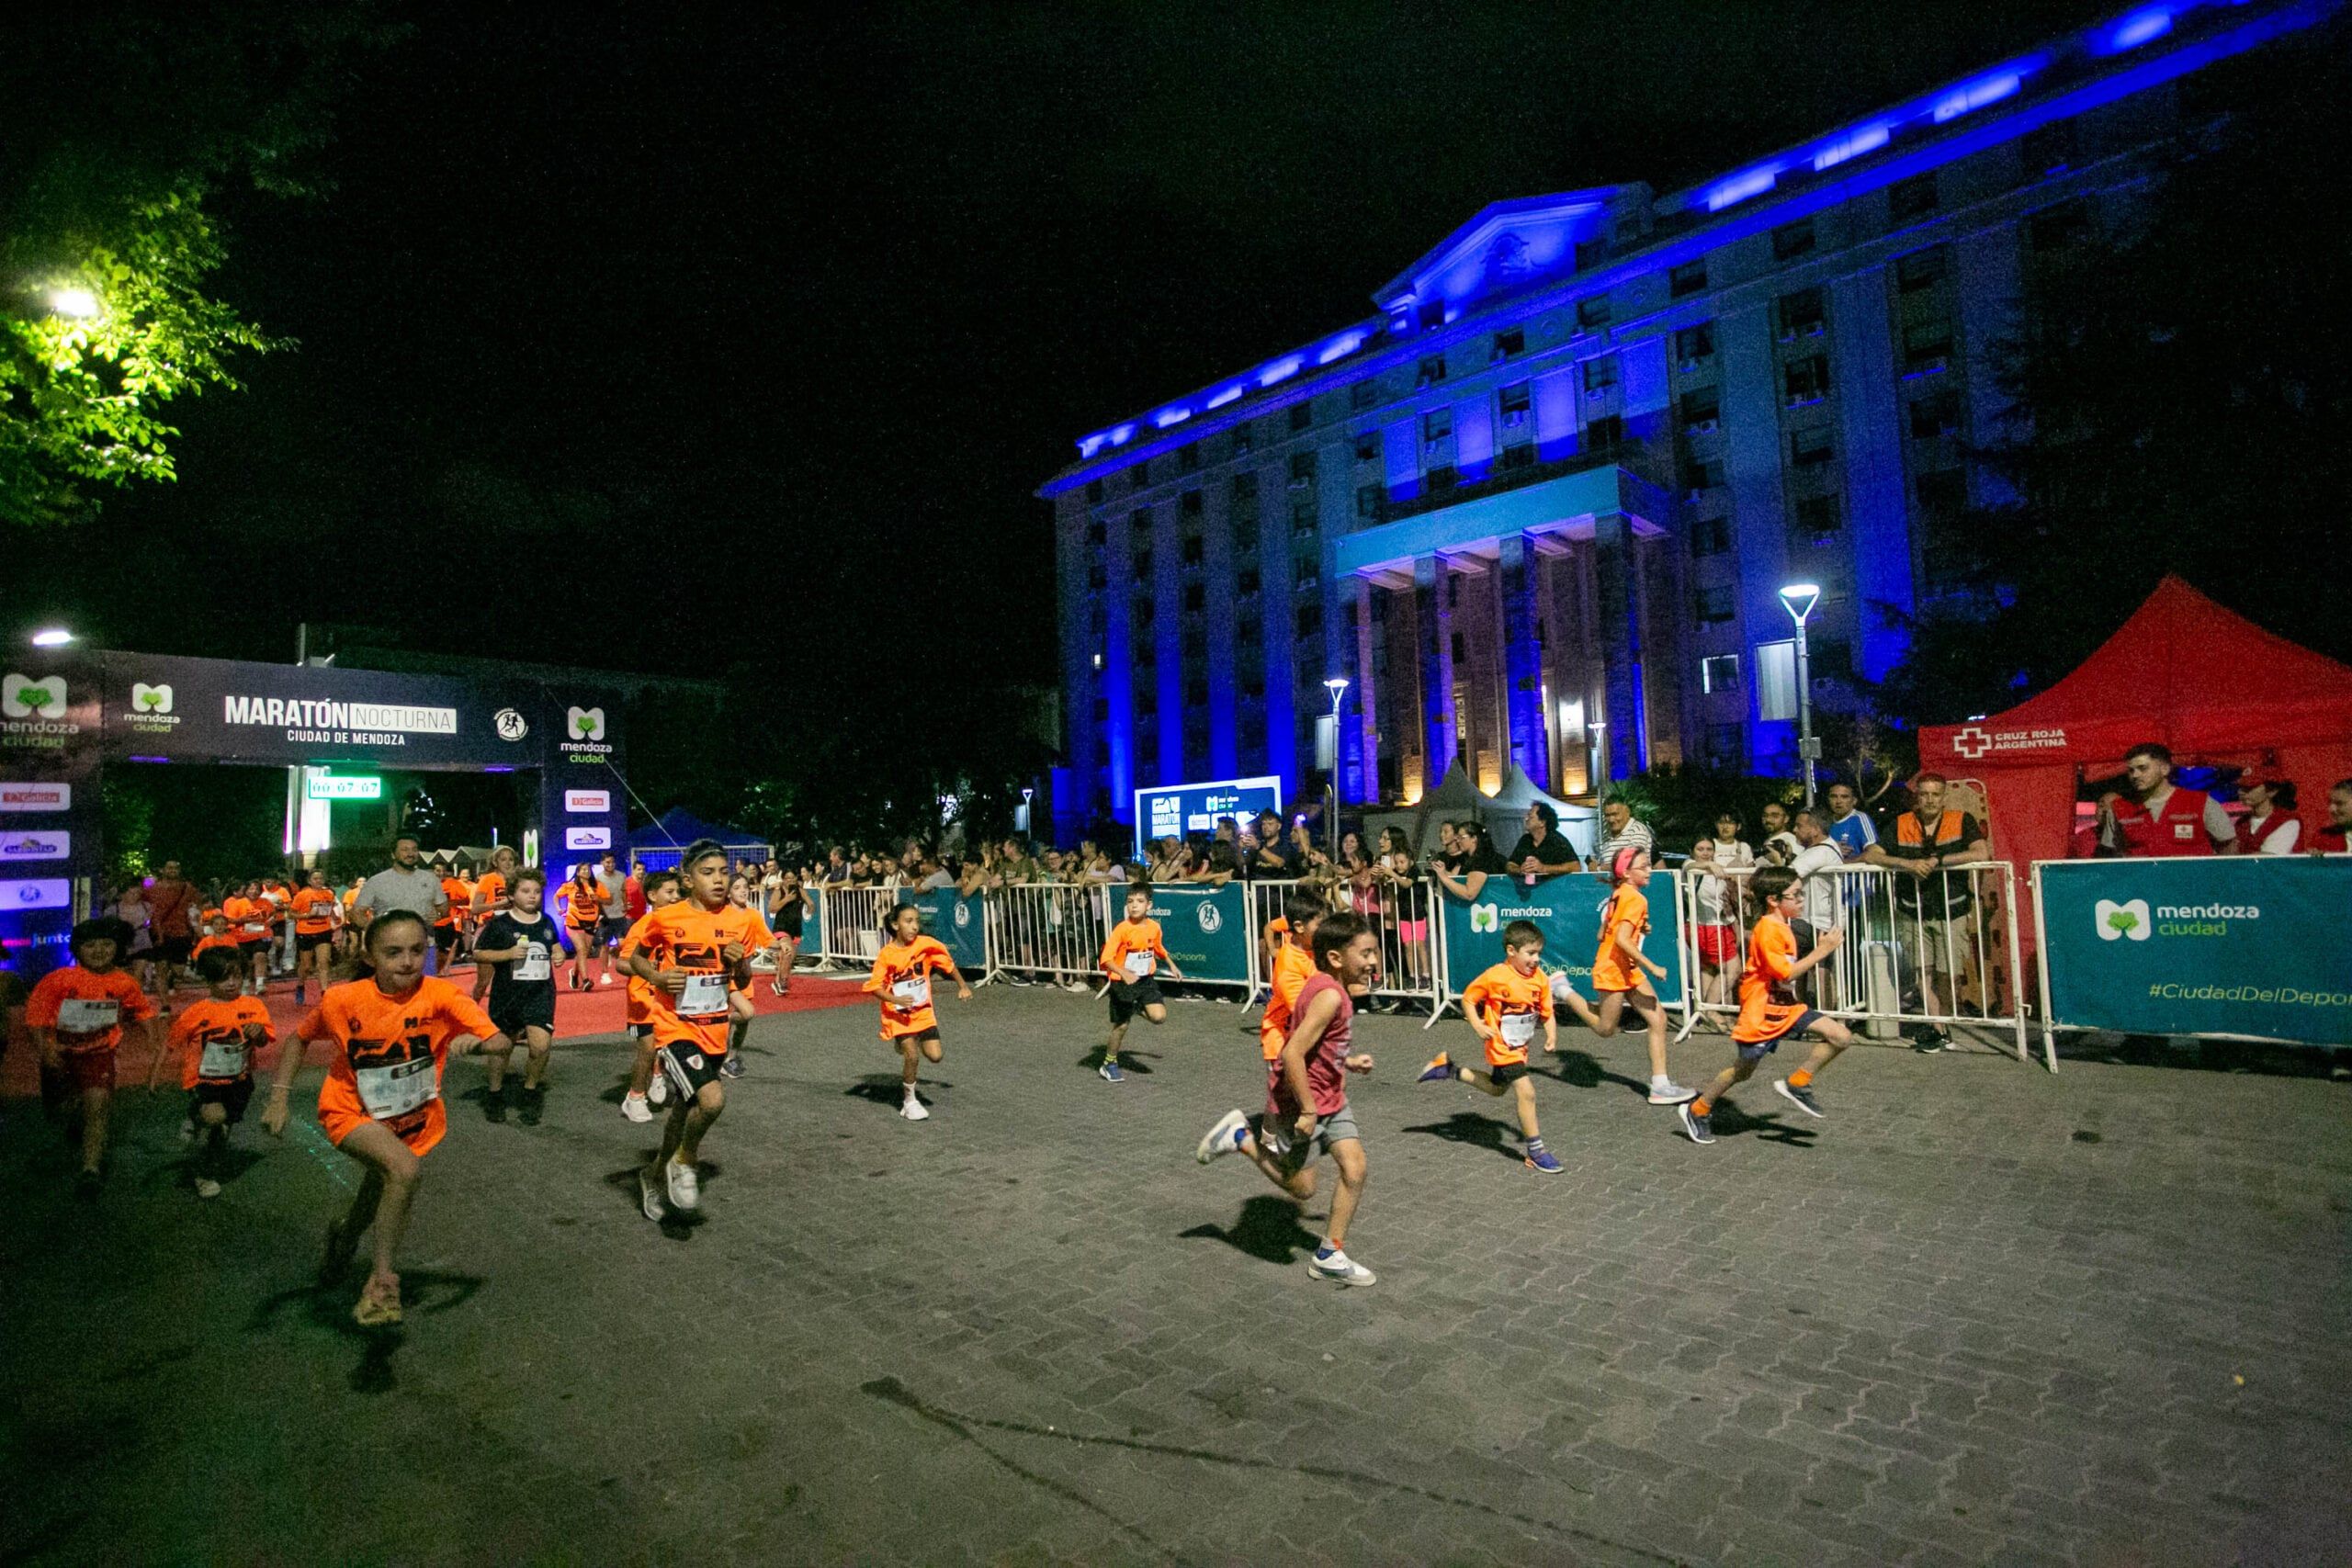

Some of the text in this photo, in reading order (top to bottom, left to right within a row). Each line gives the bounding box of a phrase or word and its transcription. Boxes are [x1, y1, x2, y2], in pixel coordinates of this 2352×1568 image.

[225, 695, 452, 730] MARATÓN NOCTURNA
[124, 714, 181, 724] mendoza
[133, 723, 172, 733] ciudad
[287, 729, 405, 746] CIUDAD DE MENDOZA
[1995, 729, 2065, 741] CRUZ ROJA
[3, 735, 65, 749] ciudad
[560, 741, 613, 753] mendoza
[1994, 738, 2068, 750] ARGENTINA
[570, 753, 605, 763] ciudad
[1147, 907, 1171, 916] endoza
[1500, 905, 1553, 918] mendoza
[2156, 902, 2260, 919] mendoza
[2159, 920, 2228, 936] ciudad
